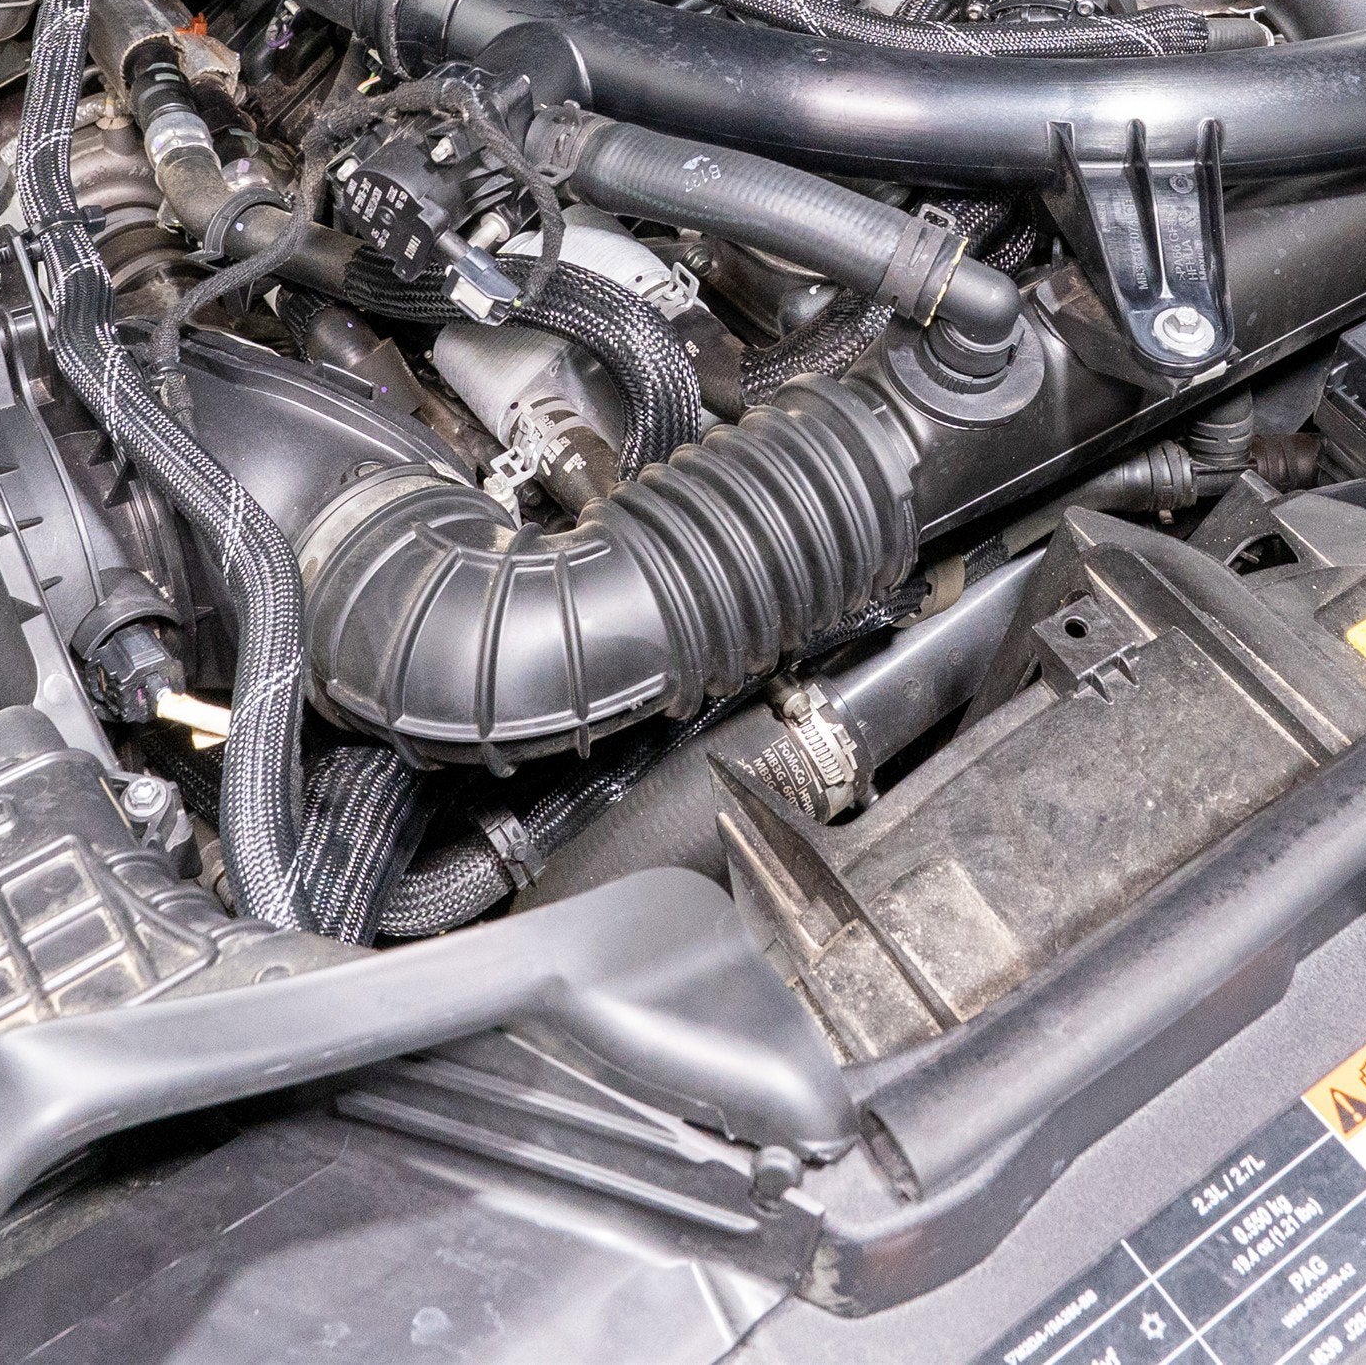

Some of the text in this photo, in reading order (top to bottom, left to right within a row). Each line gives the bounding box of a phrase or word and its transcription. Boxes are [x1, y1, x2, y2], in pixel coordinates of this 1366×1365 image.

[1182, 239, 1198, 280] HFHUA
[684, 340, 699, 357] EOC
[569, 452, 587, 470] EOC
[777, 740, 807, 785] FoMoCo
[1192, 1154, 1266, 1216] 2.3L / 2.7L
[1232, 1194, 1293, 1245] 0.550 kg
[1232, 1246, 1261, 1276] 19.4
[1268, 1215, 1300, 1248] (1.21
[1288, 1255, 1329, 1294] PAG
